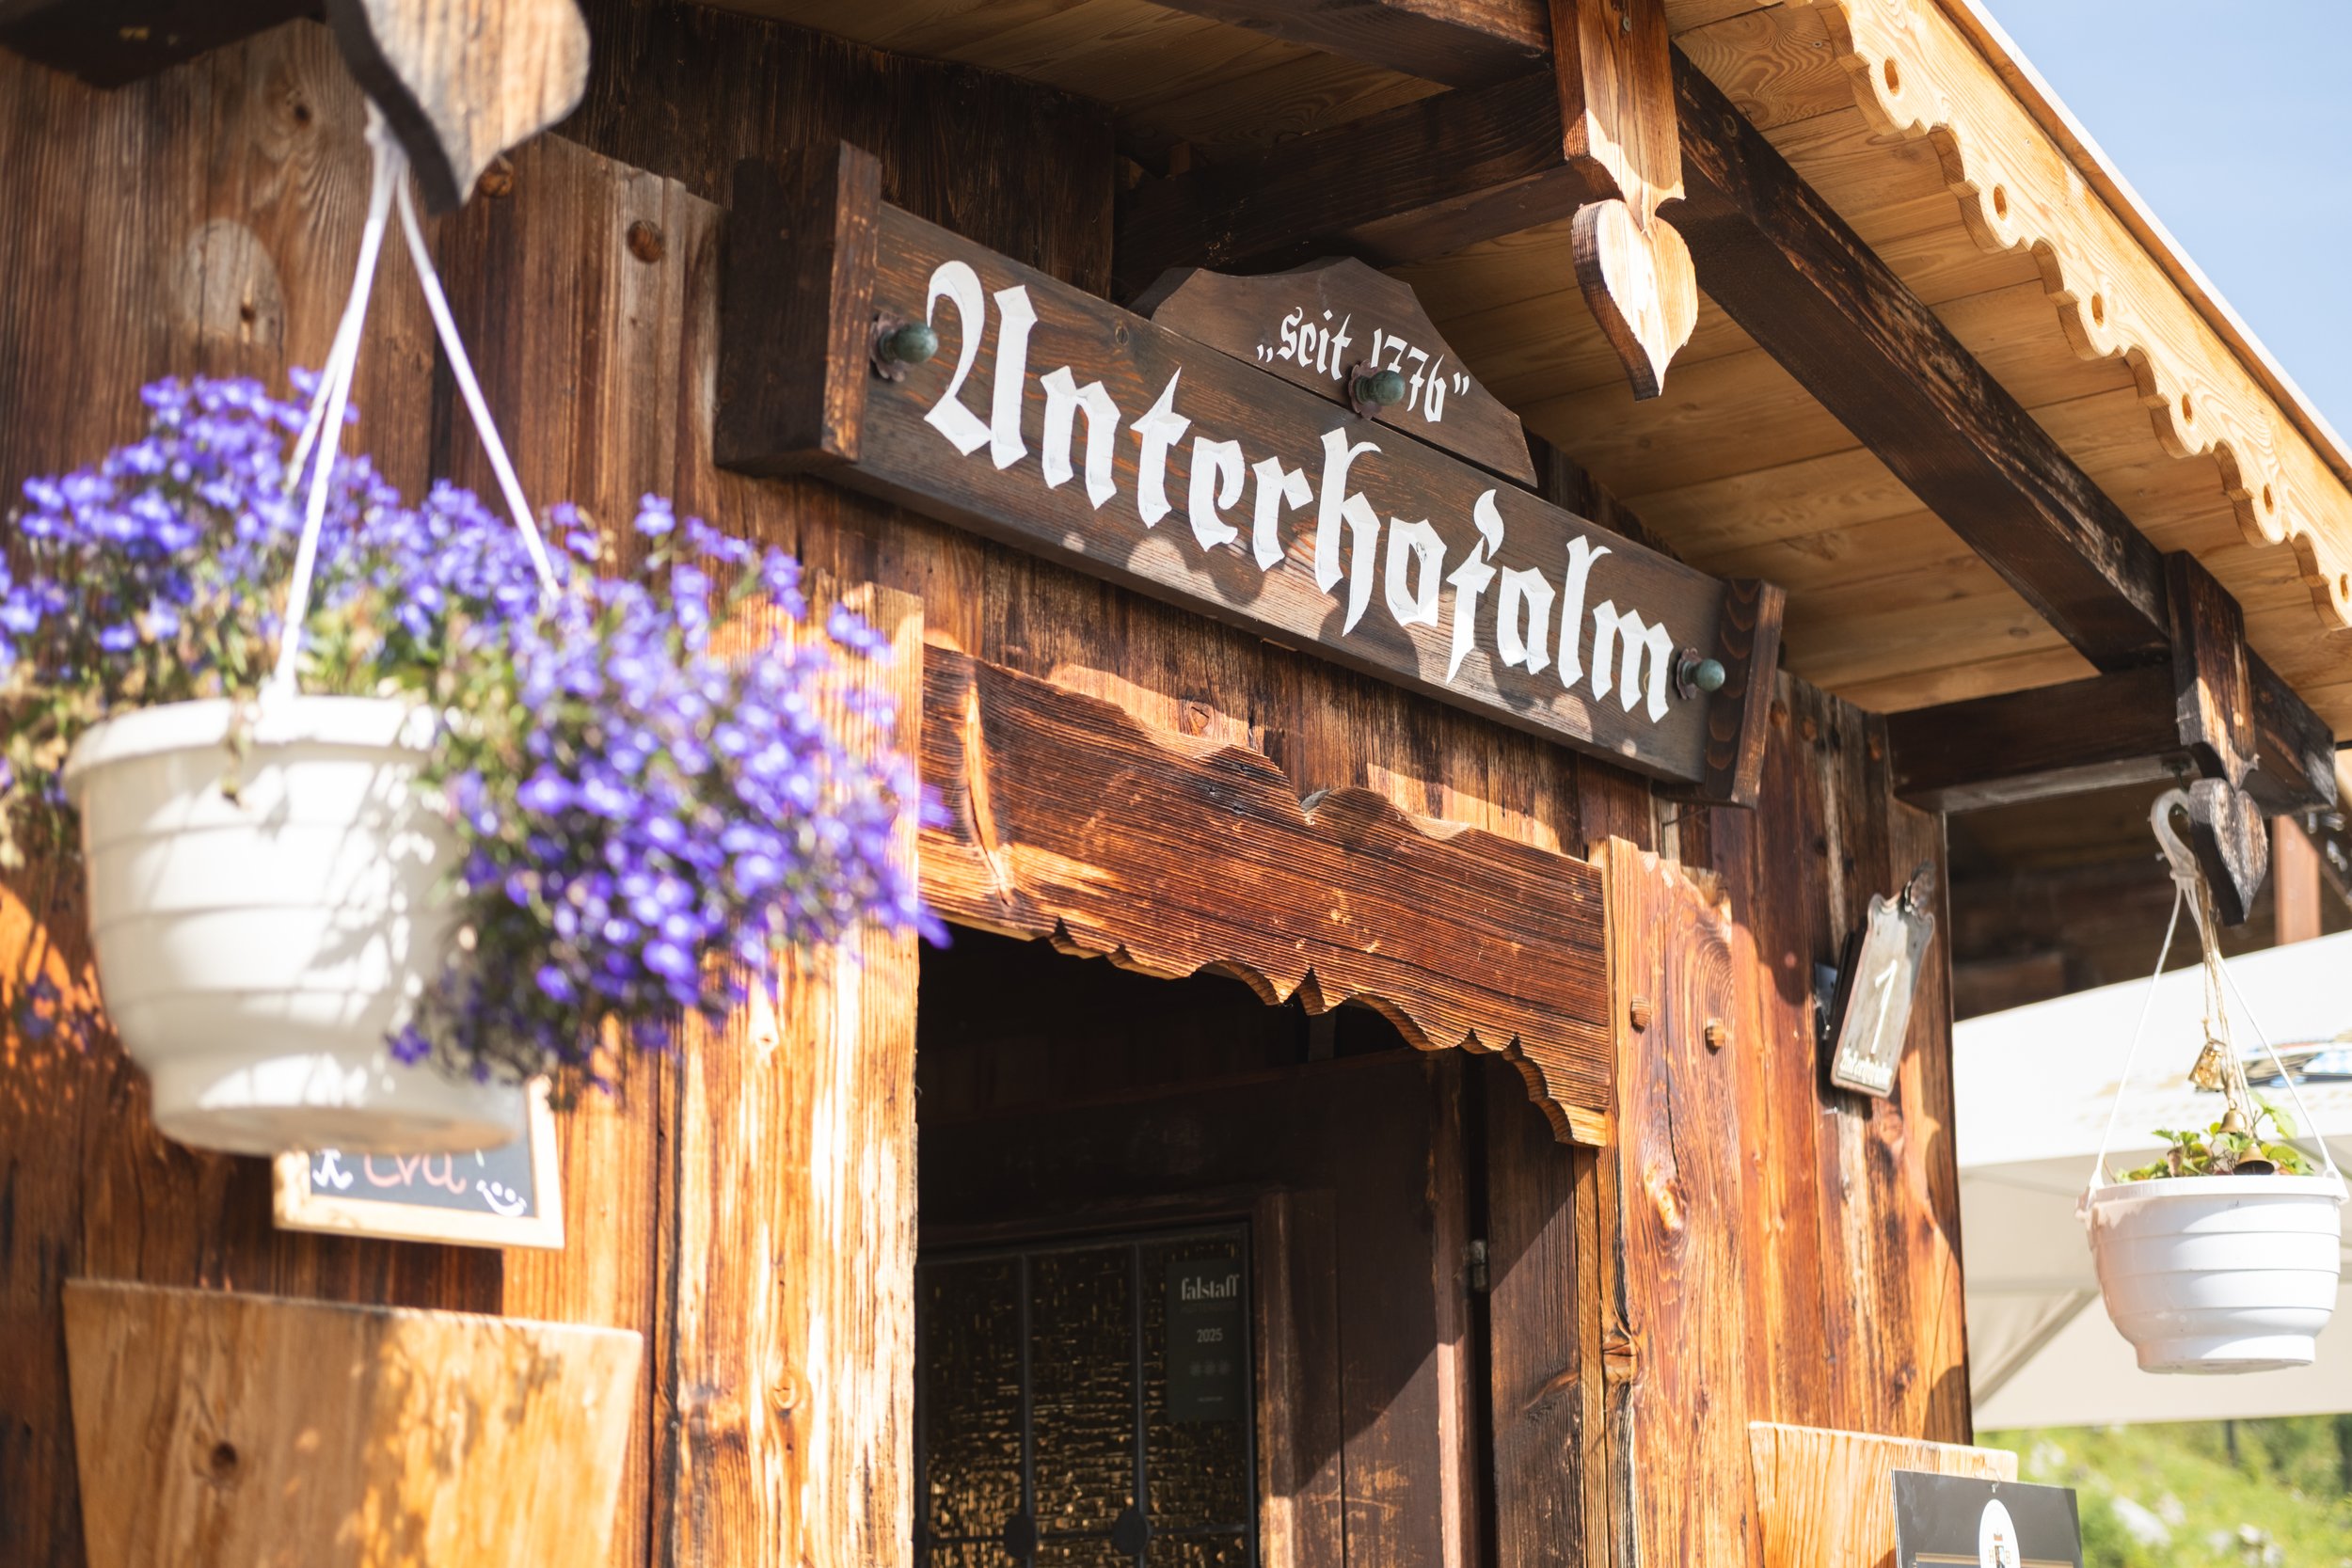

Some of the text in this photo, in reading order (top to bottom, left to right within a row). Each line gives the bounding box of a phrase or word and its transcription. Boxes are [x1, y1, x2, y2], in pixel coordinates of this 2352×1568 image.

[924, 261, 1674, 723] Unterhofalm
[1182, 1274, 1240, 1301] falstaff
[1197, 1328, 1223, 1343] 2025
